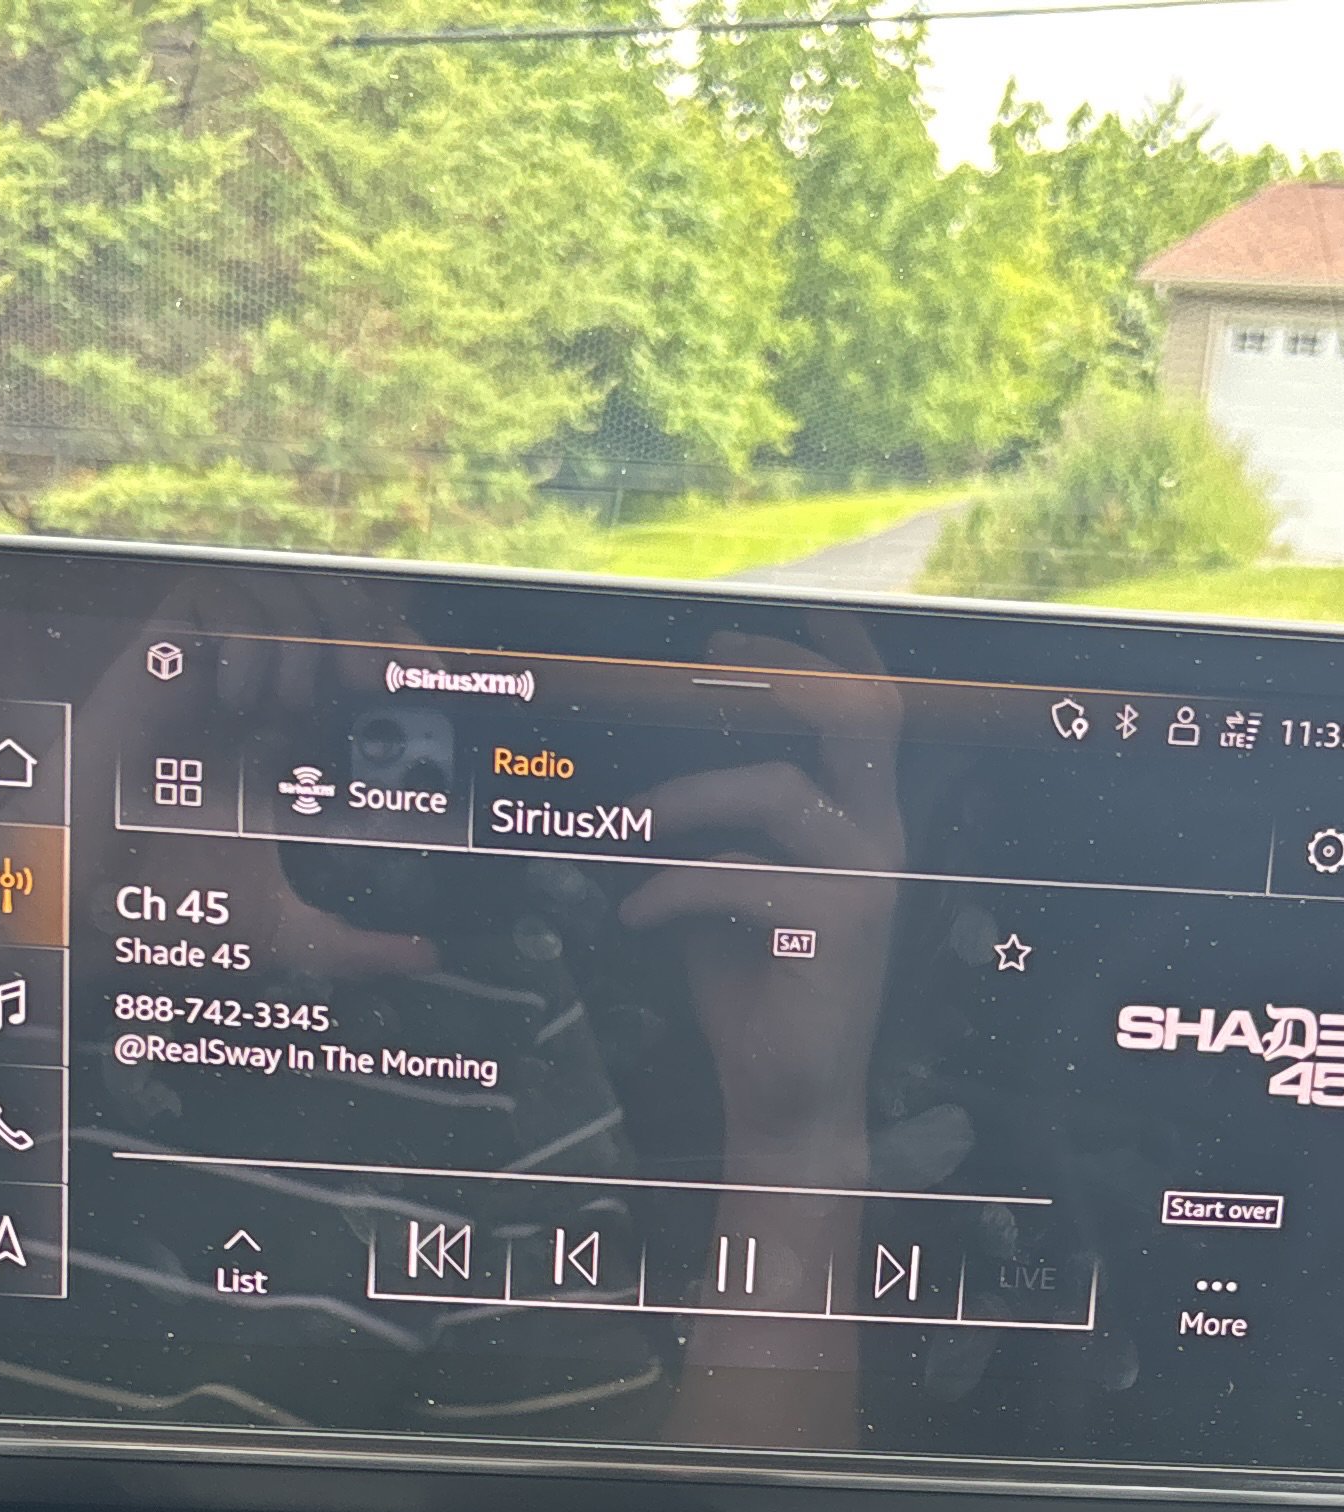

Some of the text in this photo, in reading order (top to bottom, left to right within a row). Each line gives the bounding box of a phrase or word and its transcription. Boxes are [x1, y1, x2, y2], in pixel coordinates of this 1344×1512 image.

[1219, 733, 1247, 749] LTE
[493, 747, 575, 780] Radio
[348, 781, 448, 815] Source
[491, 800, 653, 842] SiriusXM
[116, 886, 229, 924] Ch 45
[115, 937, 251, 971] Shade 45
[778, 933, 811, 954] SAT
[114, 993, 330, 1032] 888-742-3345
[114, 1034, 498, 1087] @RealSway In The Morning
[1169, 1197, 1275, 1224] Start over
[216, 1265, 268, 1295] List
[999, 1264, 1057, 1291] LIVE
[1179, 1310, 1248, 1339] More
